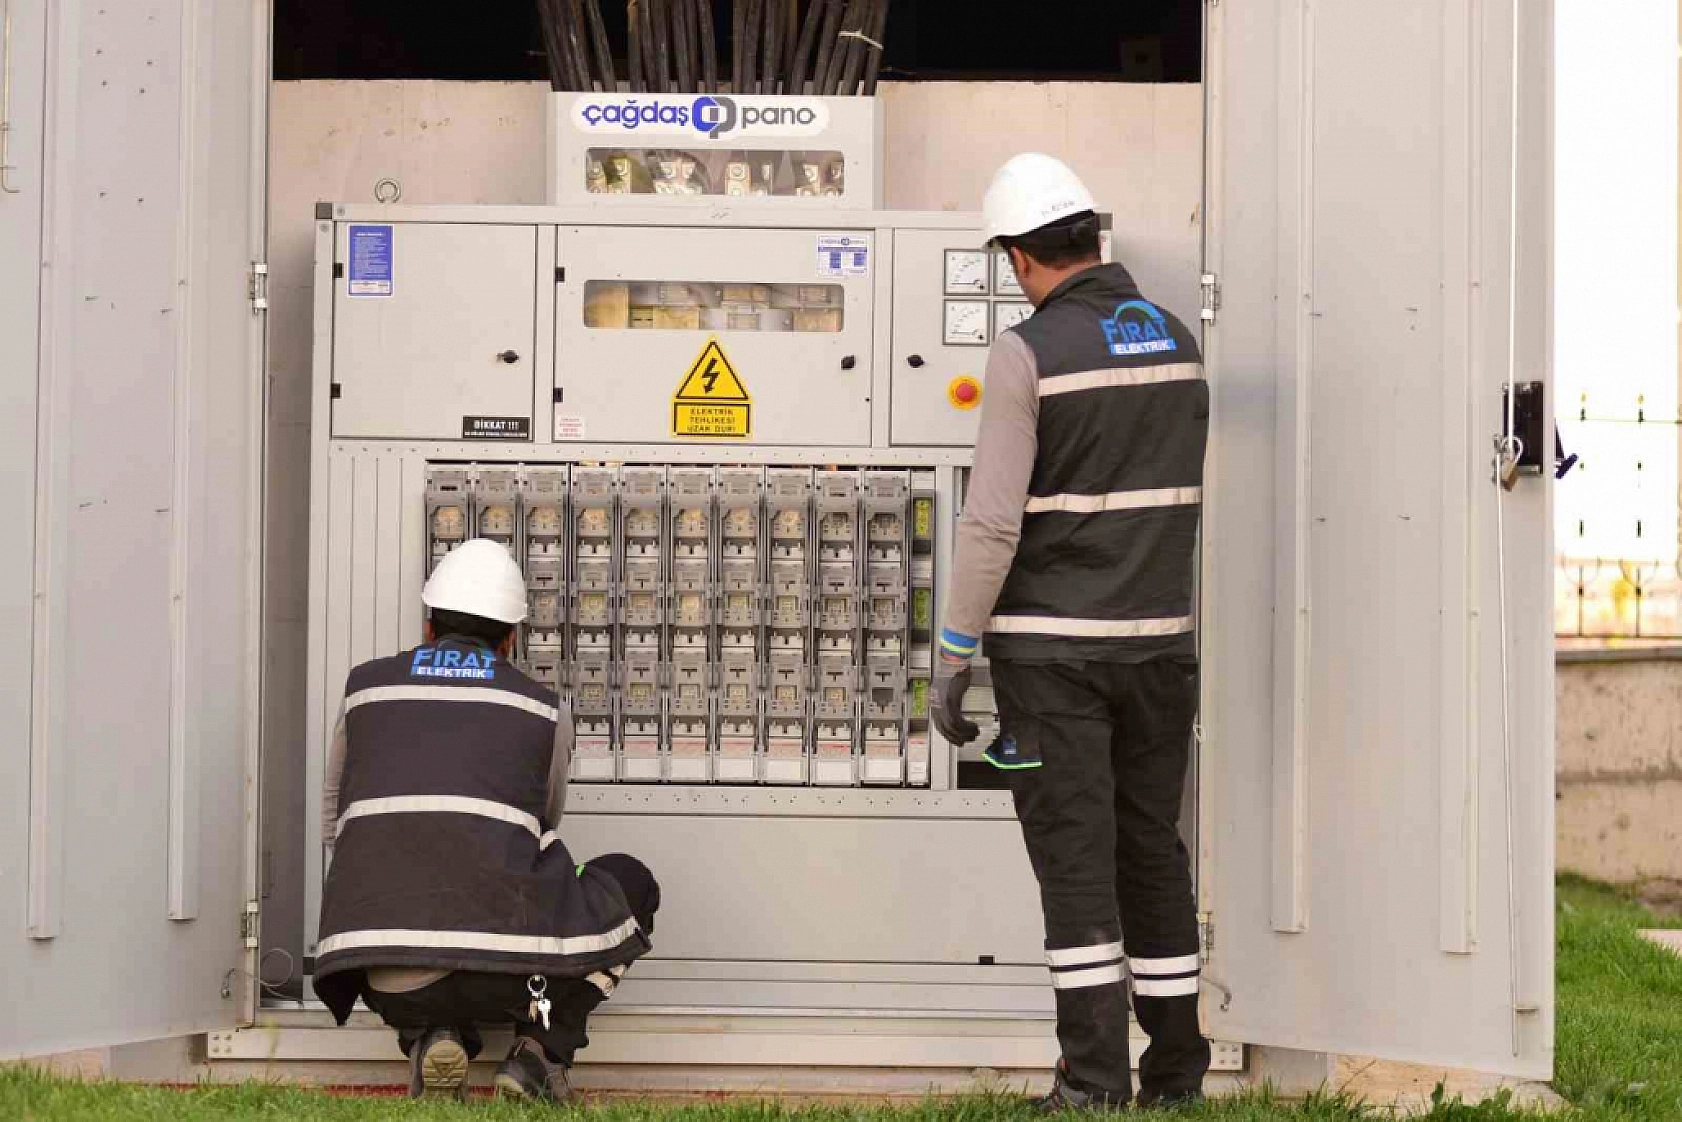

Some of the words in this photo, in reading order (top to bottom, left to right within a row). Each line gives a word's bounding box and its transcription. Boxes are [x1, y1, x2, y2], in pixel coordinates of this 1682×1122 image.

[582, 99, 688, 129] çağdaş
[742, 107, 816, 129] pano
[1099, 317, 1168, 343] FIRAT
[413, 648, 496, 668] FIRAT
